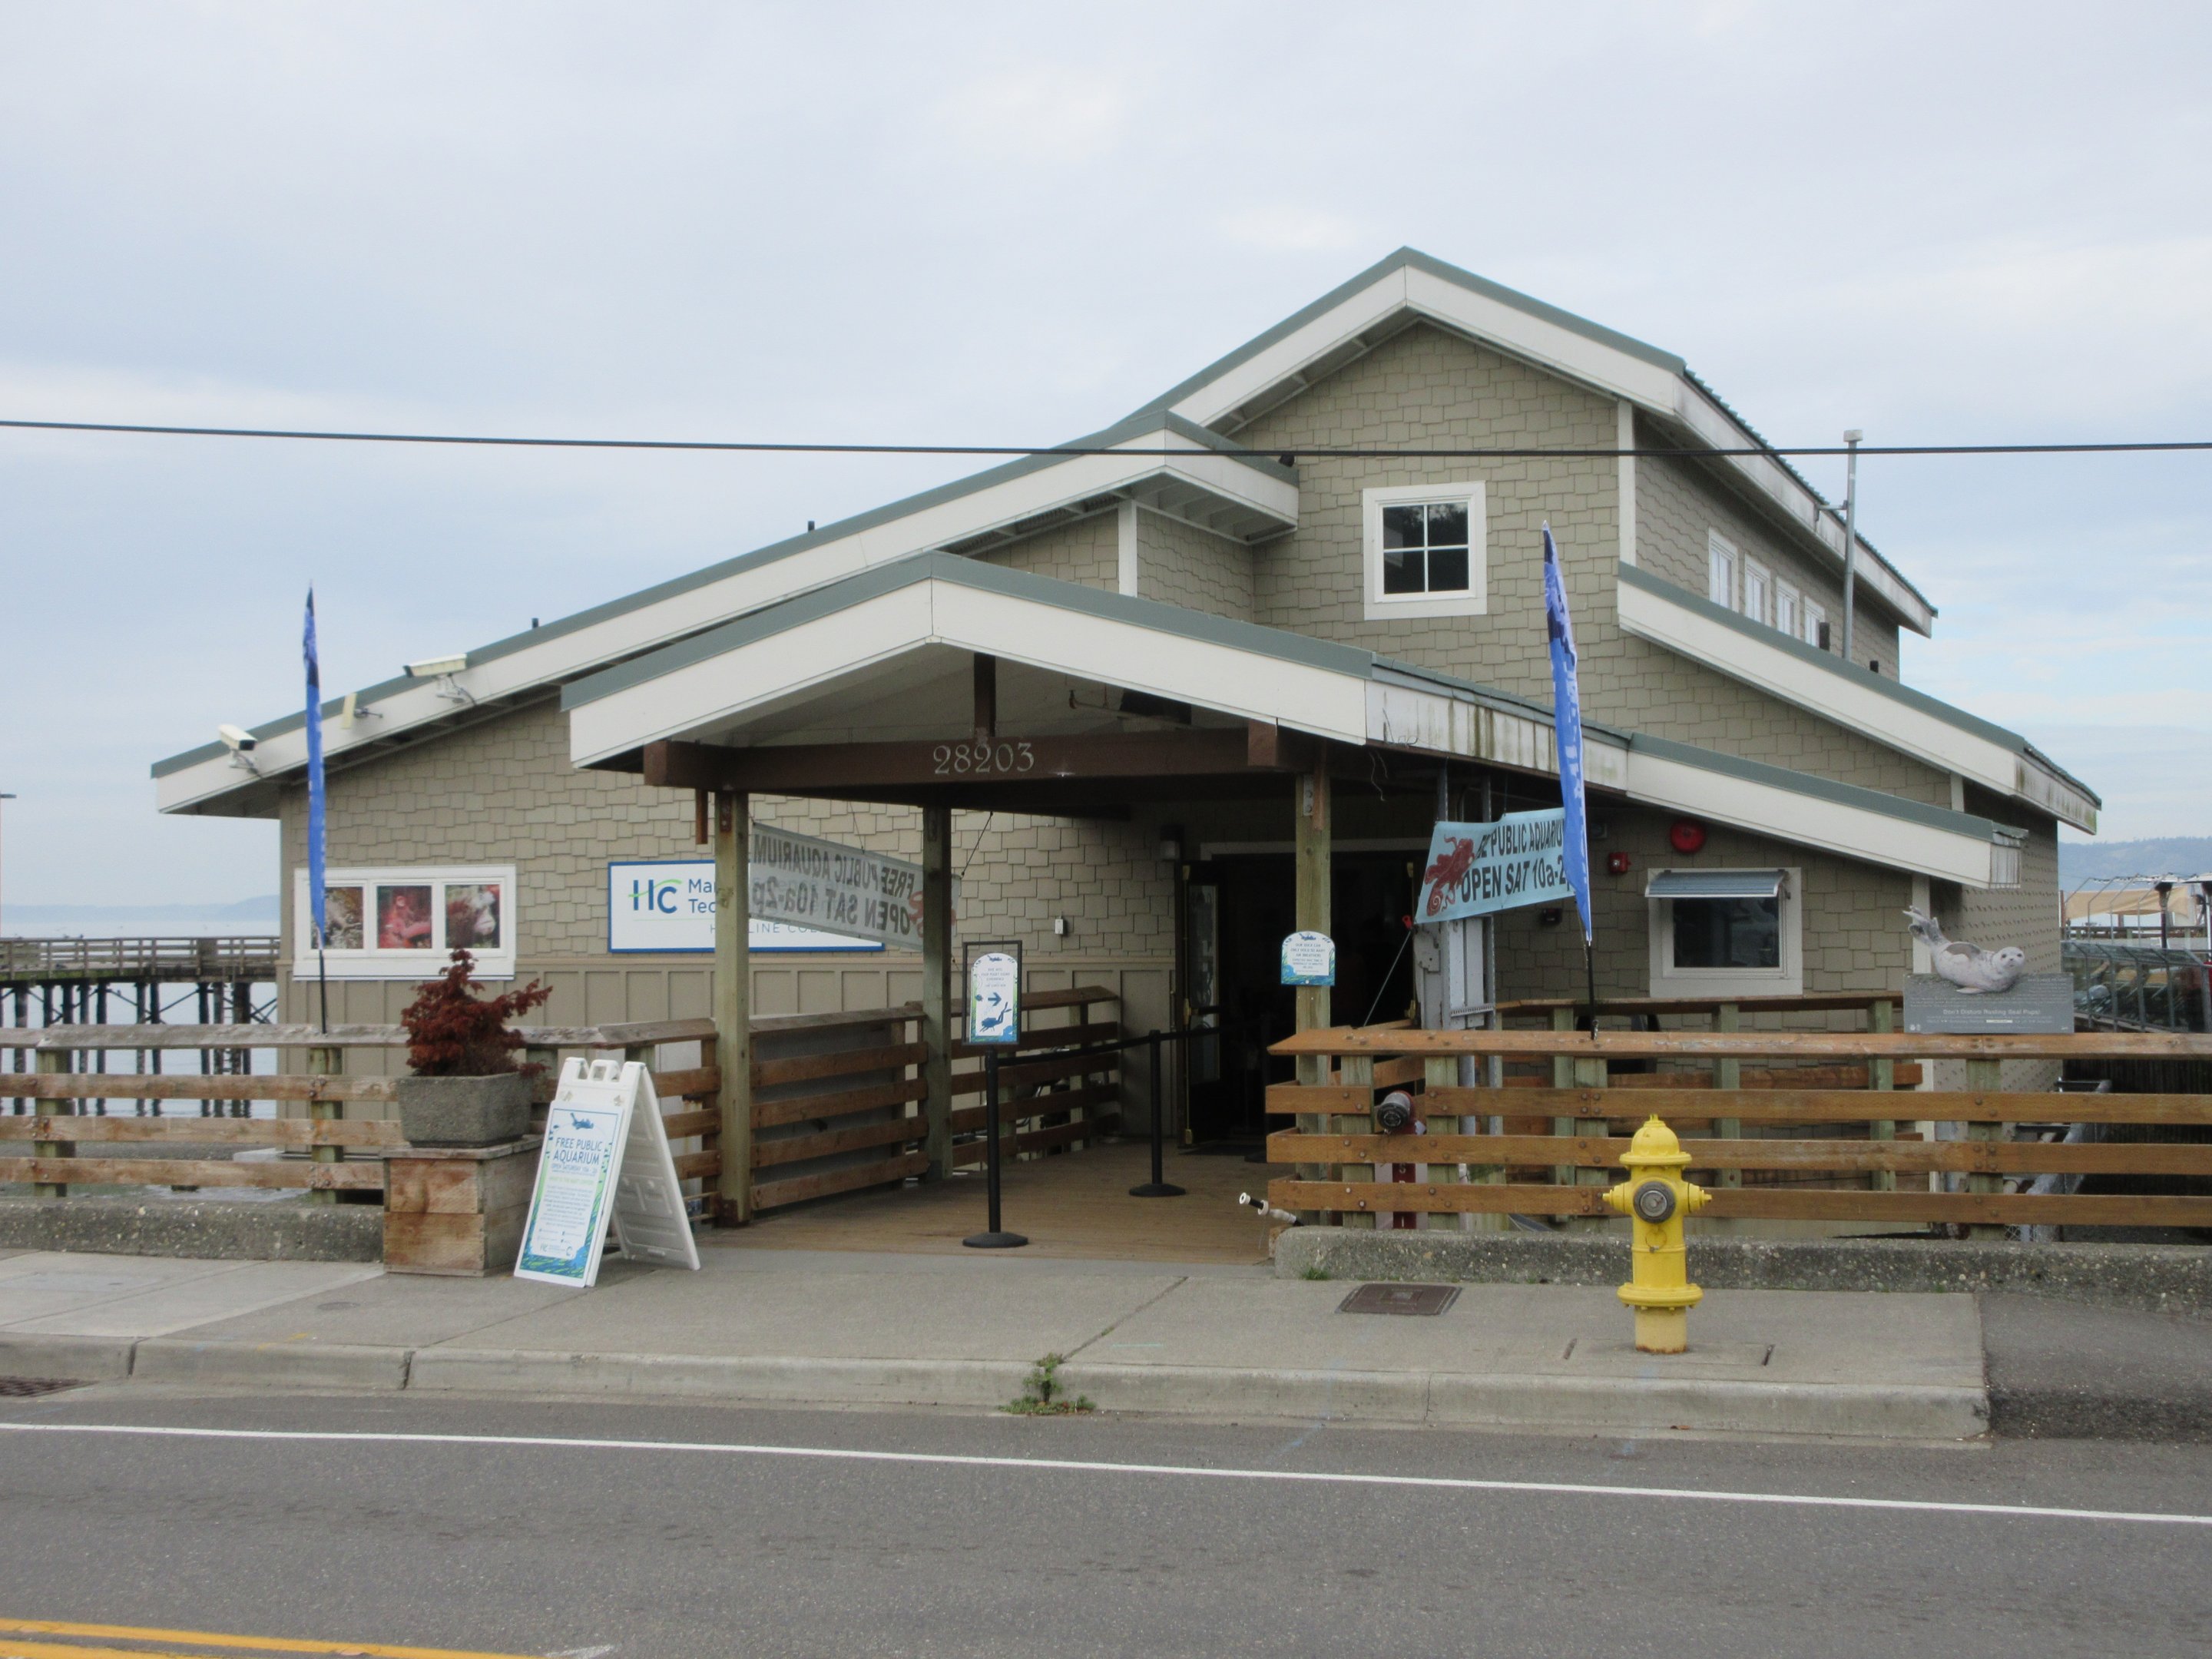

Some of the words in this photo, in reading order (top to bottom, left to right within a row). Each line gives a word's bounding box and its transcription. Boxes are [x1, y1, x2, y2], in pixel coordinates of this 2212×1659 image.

[933, 742, 1035, 774] 28203
[1491, 823, 1527, 857] PUBLIC
[1528, 818, 1565, 853] AQUARIU
[1461, 864, 1502, 902] OPEN
[1505, 861, 1531, 895] SAT
[553, 1149, 599, 1165] AQUARIUM
[555, 1137, 575, 1149] FREE
[576, 1139, 603, 1151] PUBLIC
